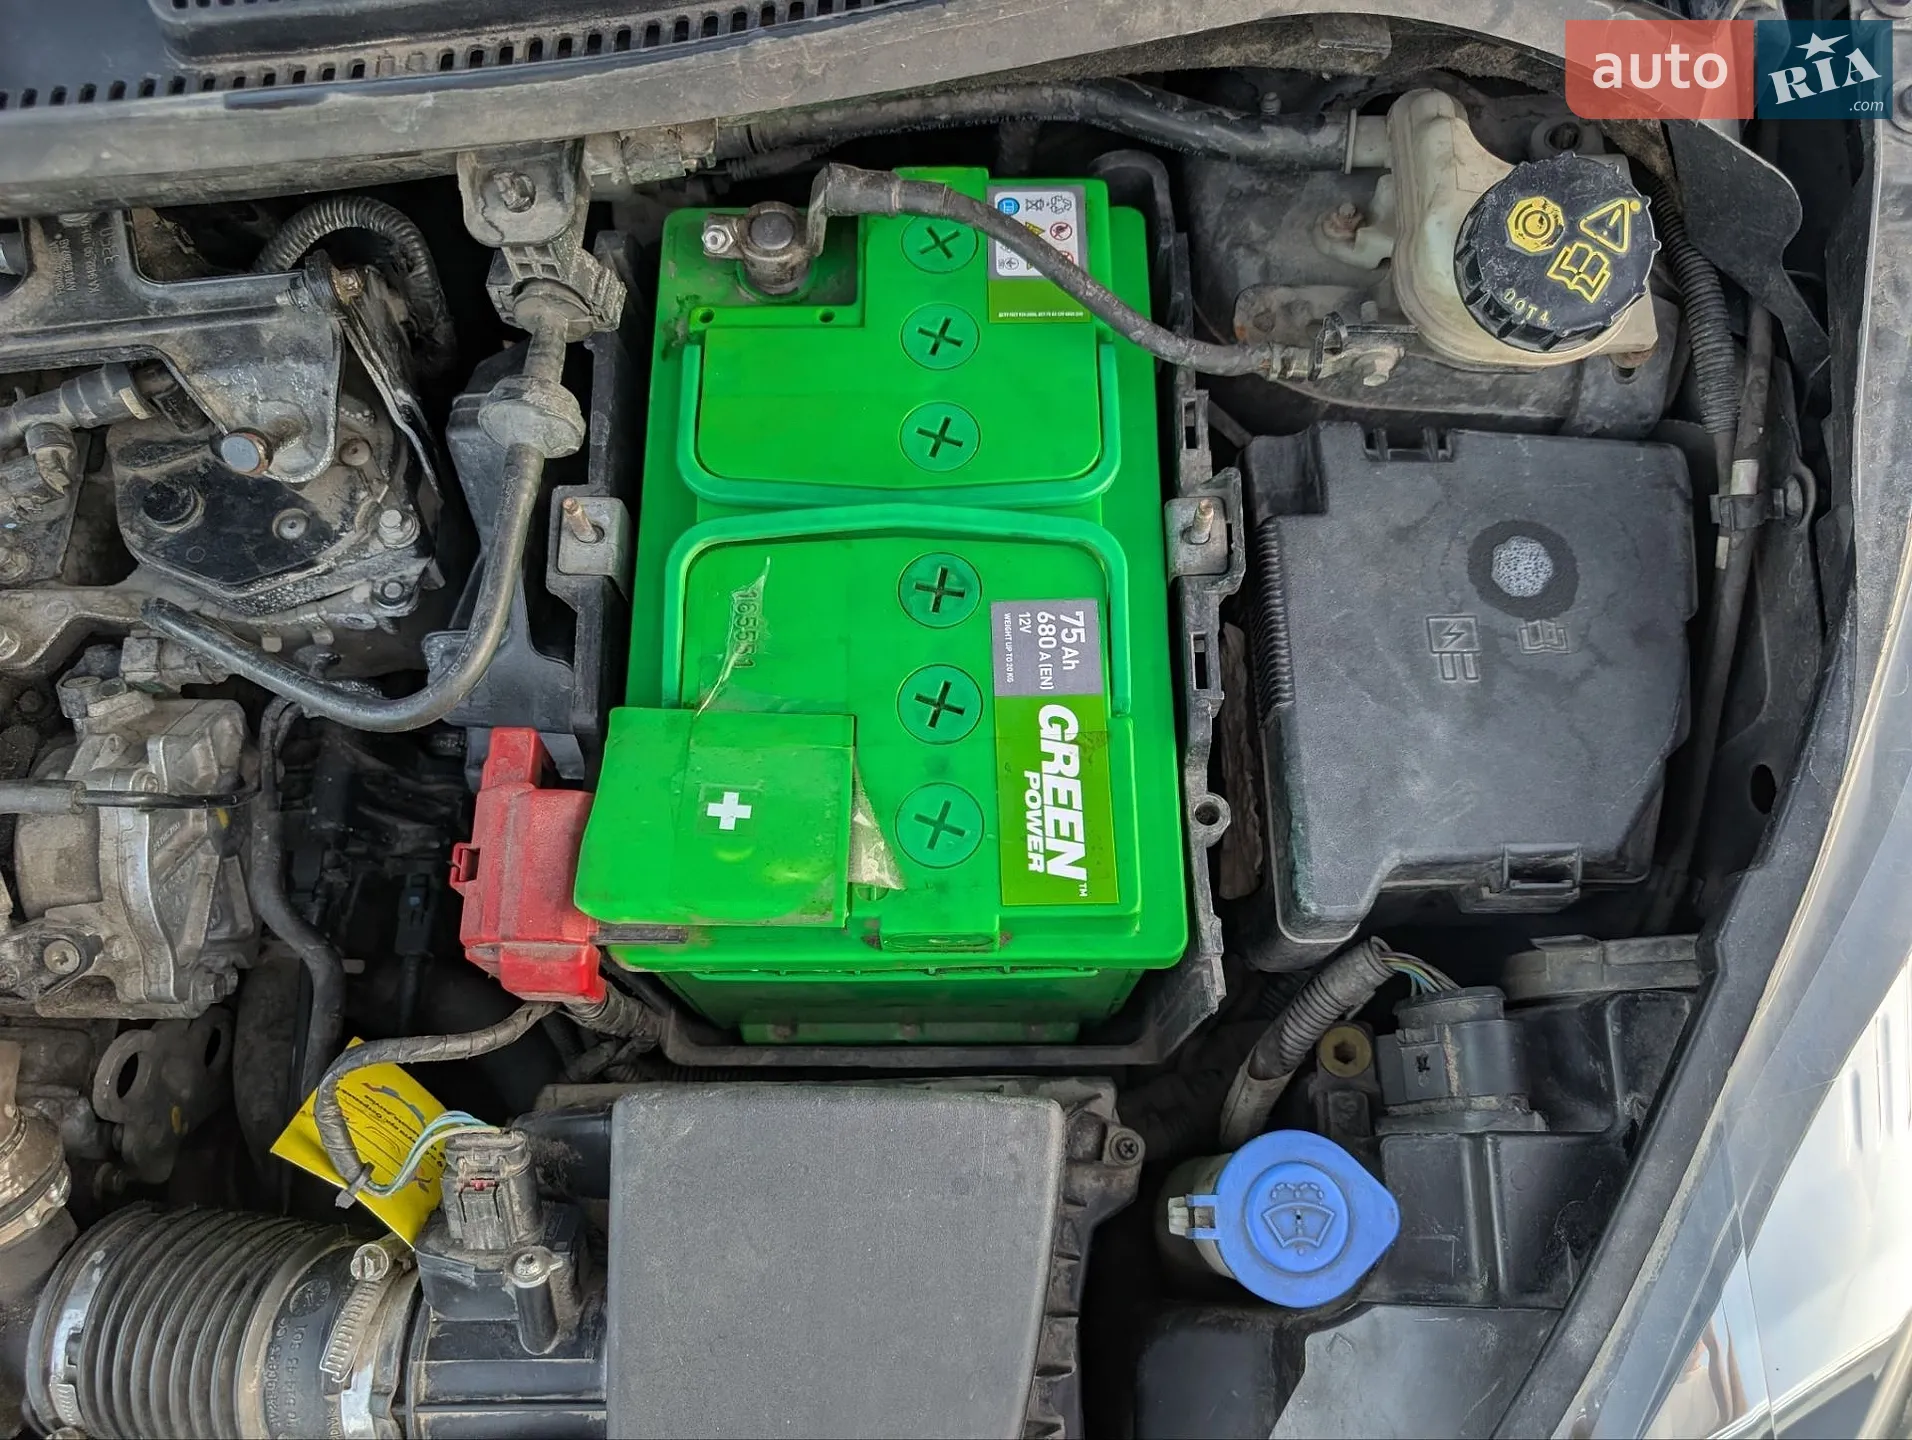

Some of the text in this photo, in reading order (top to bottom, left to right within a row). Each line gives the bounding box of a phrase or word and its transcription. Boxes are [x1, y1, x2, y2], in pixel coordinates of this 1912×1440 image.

[1004, 612, 1013, 641] WEIGHT
[1018, 611, 1032, 634] 12V
[1005, 642, 1013, 652] UP
[1005, 653, 1013, 662] TO
[1037, 611, 1057, 690] 680 A (EN)
[1006, 663, 1014, 672] 20
[1038, 704, 1088, 881] GREEN
[1023, 770, 1045, 873] POWER
